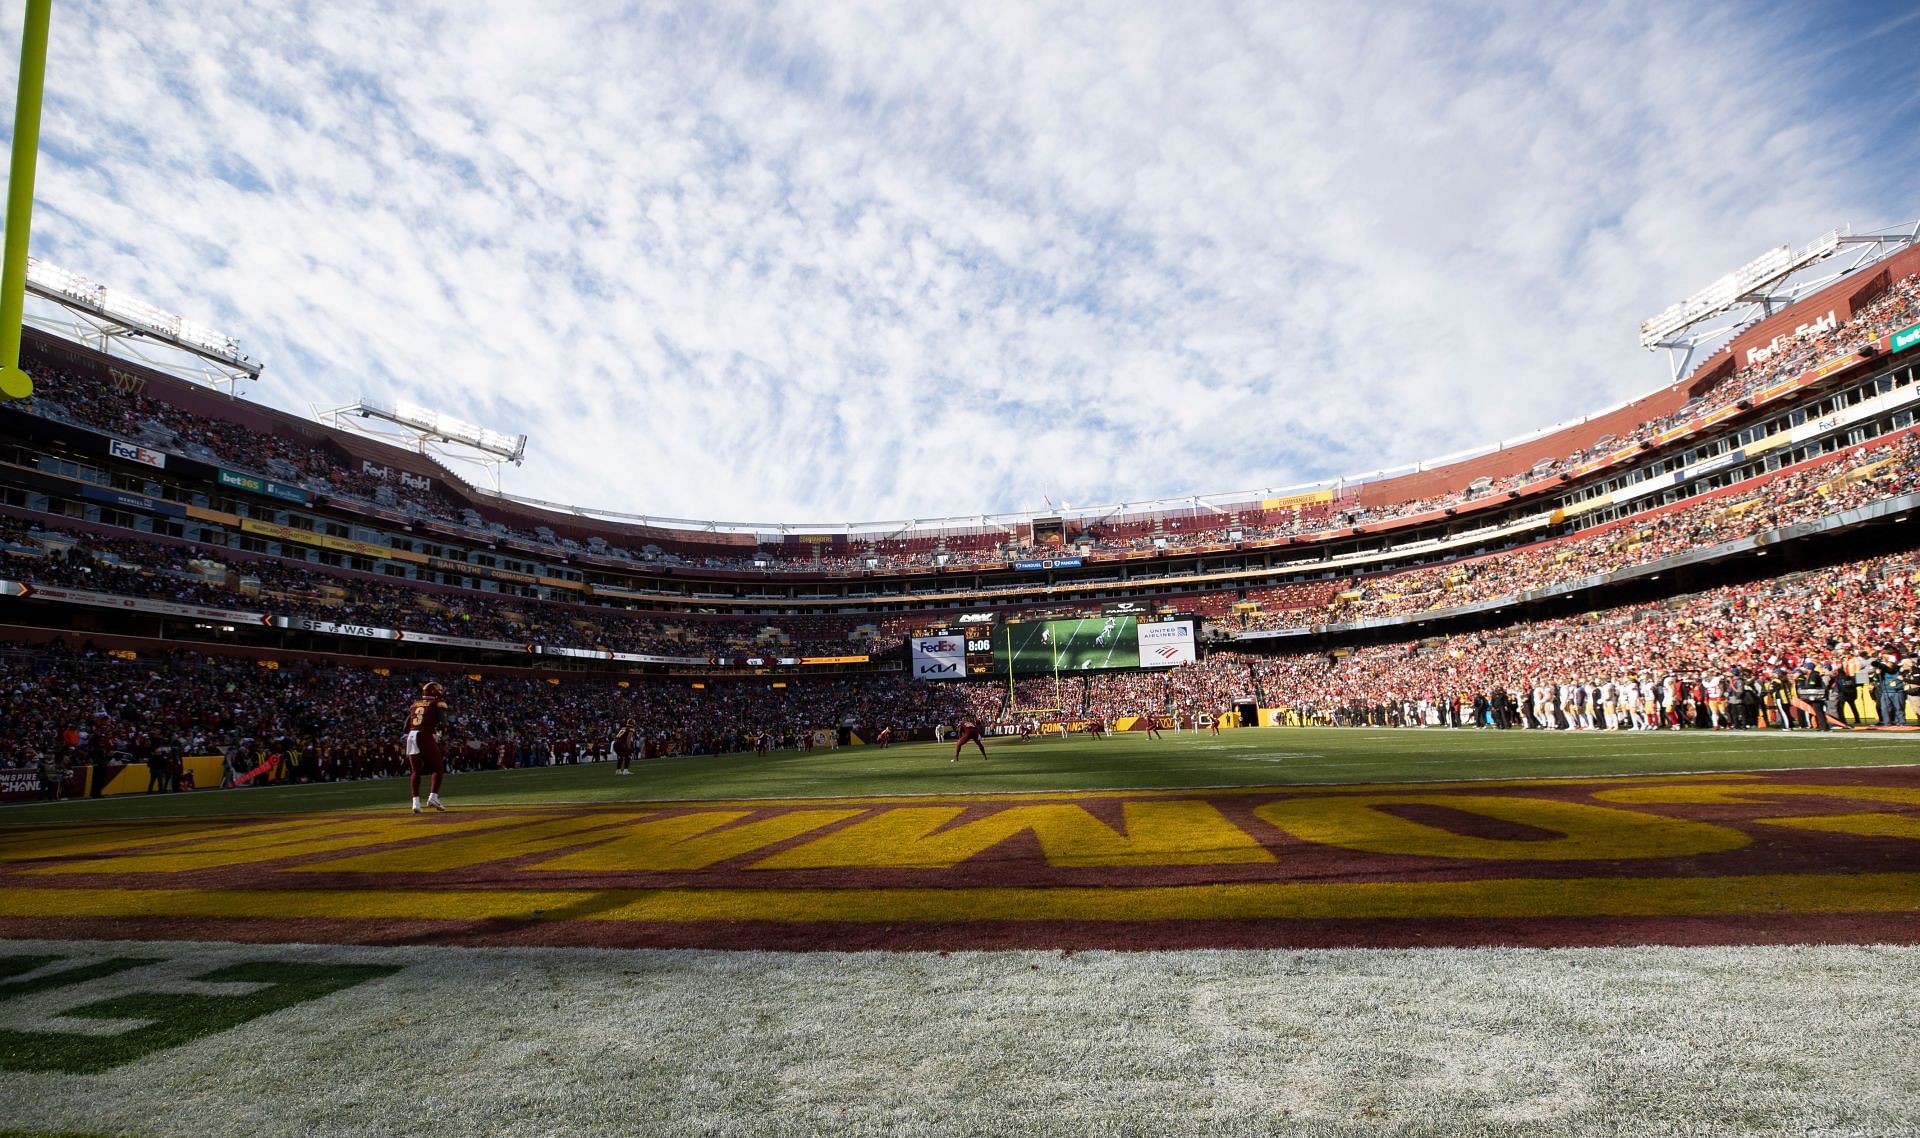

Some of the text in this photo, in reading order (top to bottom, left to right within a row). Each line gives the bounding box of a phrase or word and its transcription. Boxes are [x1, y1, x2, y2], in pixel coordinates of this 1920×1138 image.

[1818, 415, 1847, 431] FedEx
[112, 441, 157, 465] FedEx
[222, 472, 260, 490] bet365
[437, 560, 454, 570] HAIL
[457, 563, 466, 572] TO
[491, 570, 537, 583] COMMANDERS
[1106, 607, 1147, 615] FANDUEL
[302, 620, 322, 631] SF
[344, 625, 374, 637] WAS
[920, 640, 956, 653] FedEx
[968, 639, 990, 652] 8:06
[920, 663, 957, 674] KIA
[412, 706, 425, 727] 3
[1004, 725, 1014, 735] TO
